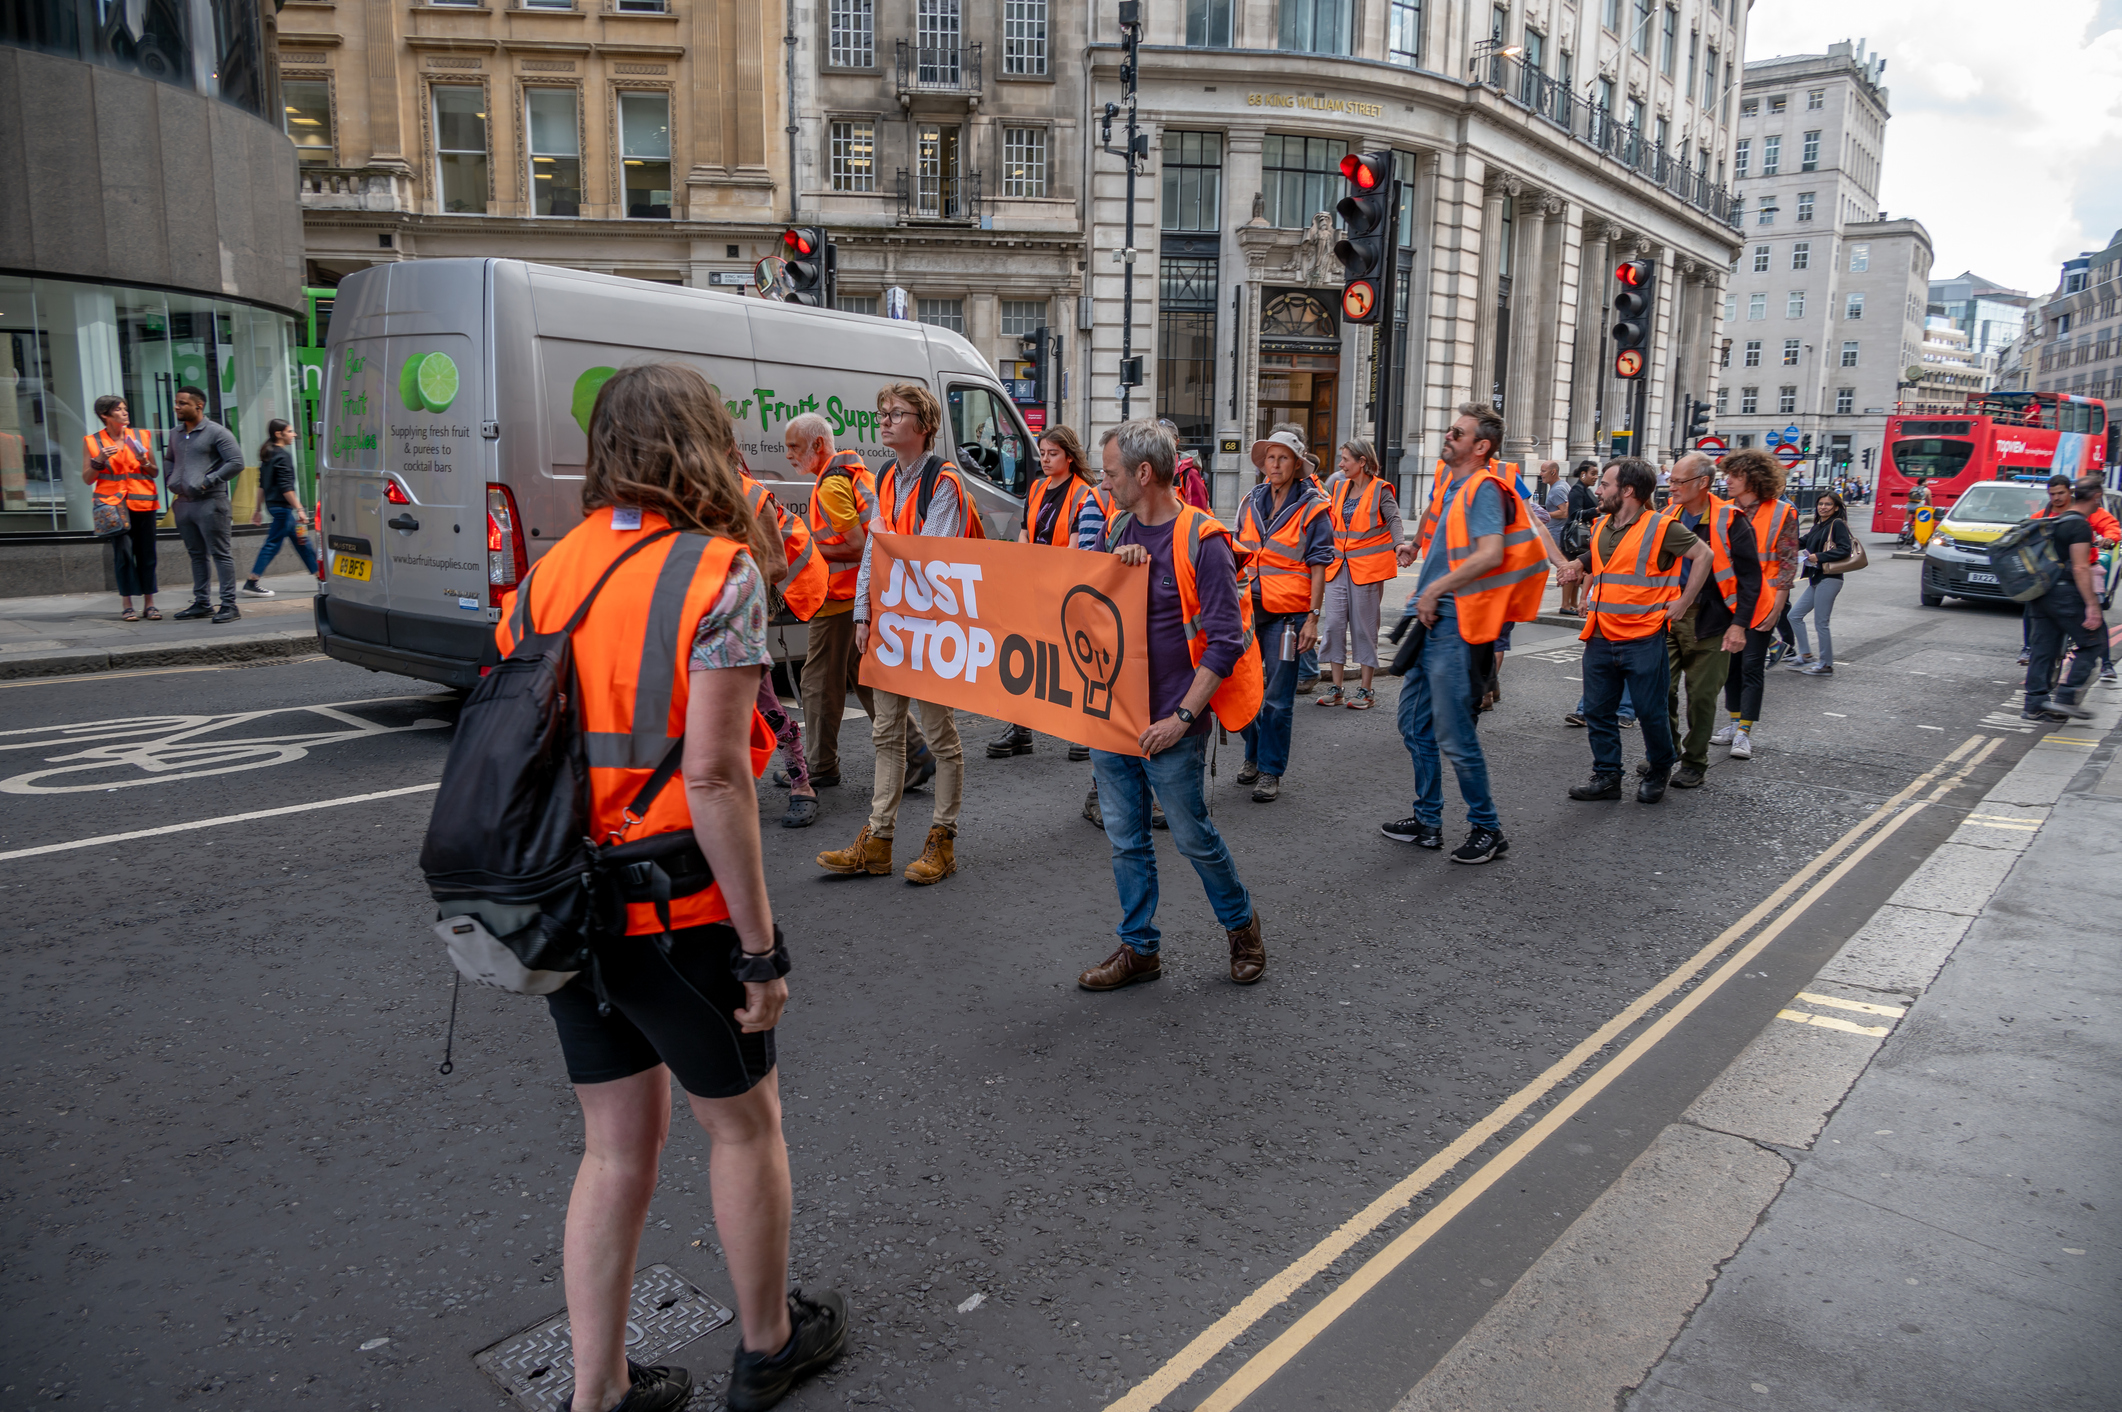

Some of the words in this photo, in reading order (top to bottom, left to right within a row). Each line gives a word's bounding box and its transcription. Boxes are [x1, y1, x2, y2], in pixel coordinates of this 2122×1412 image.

[1248, 93, 1263, 106] 68
[1265, 94, 1294, 108] KING
[1297, 96, 1345, 112] WILLIAM
[1346, 101, 1384, 117] STREET
[345, 348, 367, 381] Bar
[342, 390, 368, 423] Fruit
[826, 395, 882, 443] Supp
[333, 424, 377, 462] Supplies
[390, 425, 428, 440] Supplying
[429, 425, 450, 437] fresh
[451, 425, 470, 438] fruit
[404, 443, 411, 454] &
[442, 444, 451, 455] to
[760, 440, 785, 453] fresh
[867, 446, 897, 458] cockta
[1225, 441, 1236, 450] 68
[403, 460, 432, 472] cocktail
[434, 461, 452, 473] bars
[349, 559, 365, 577] BFS
[392, 554, 480, 572] www.barfruitsupplies.com
[880, 557, 983, 619] JUST
[876, 611, 995, 683] STOP
[999, 633, 1073, 708] OIL
[628, 1338, 667, 1361] DUDLEY
[667, 1327, 688, 1340] LTD
